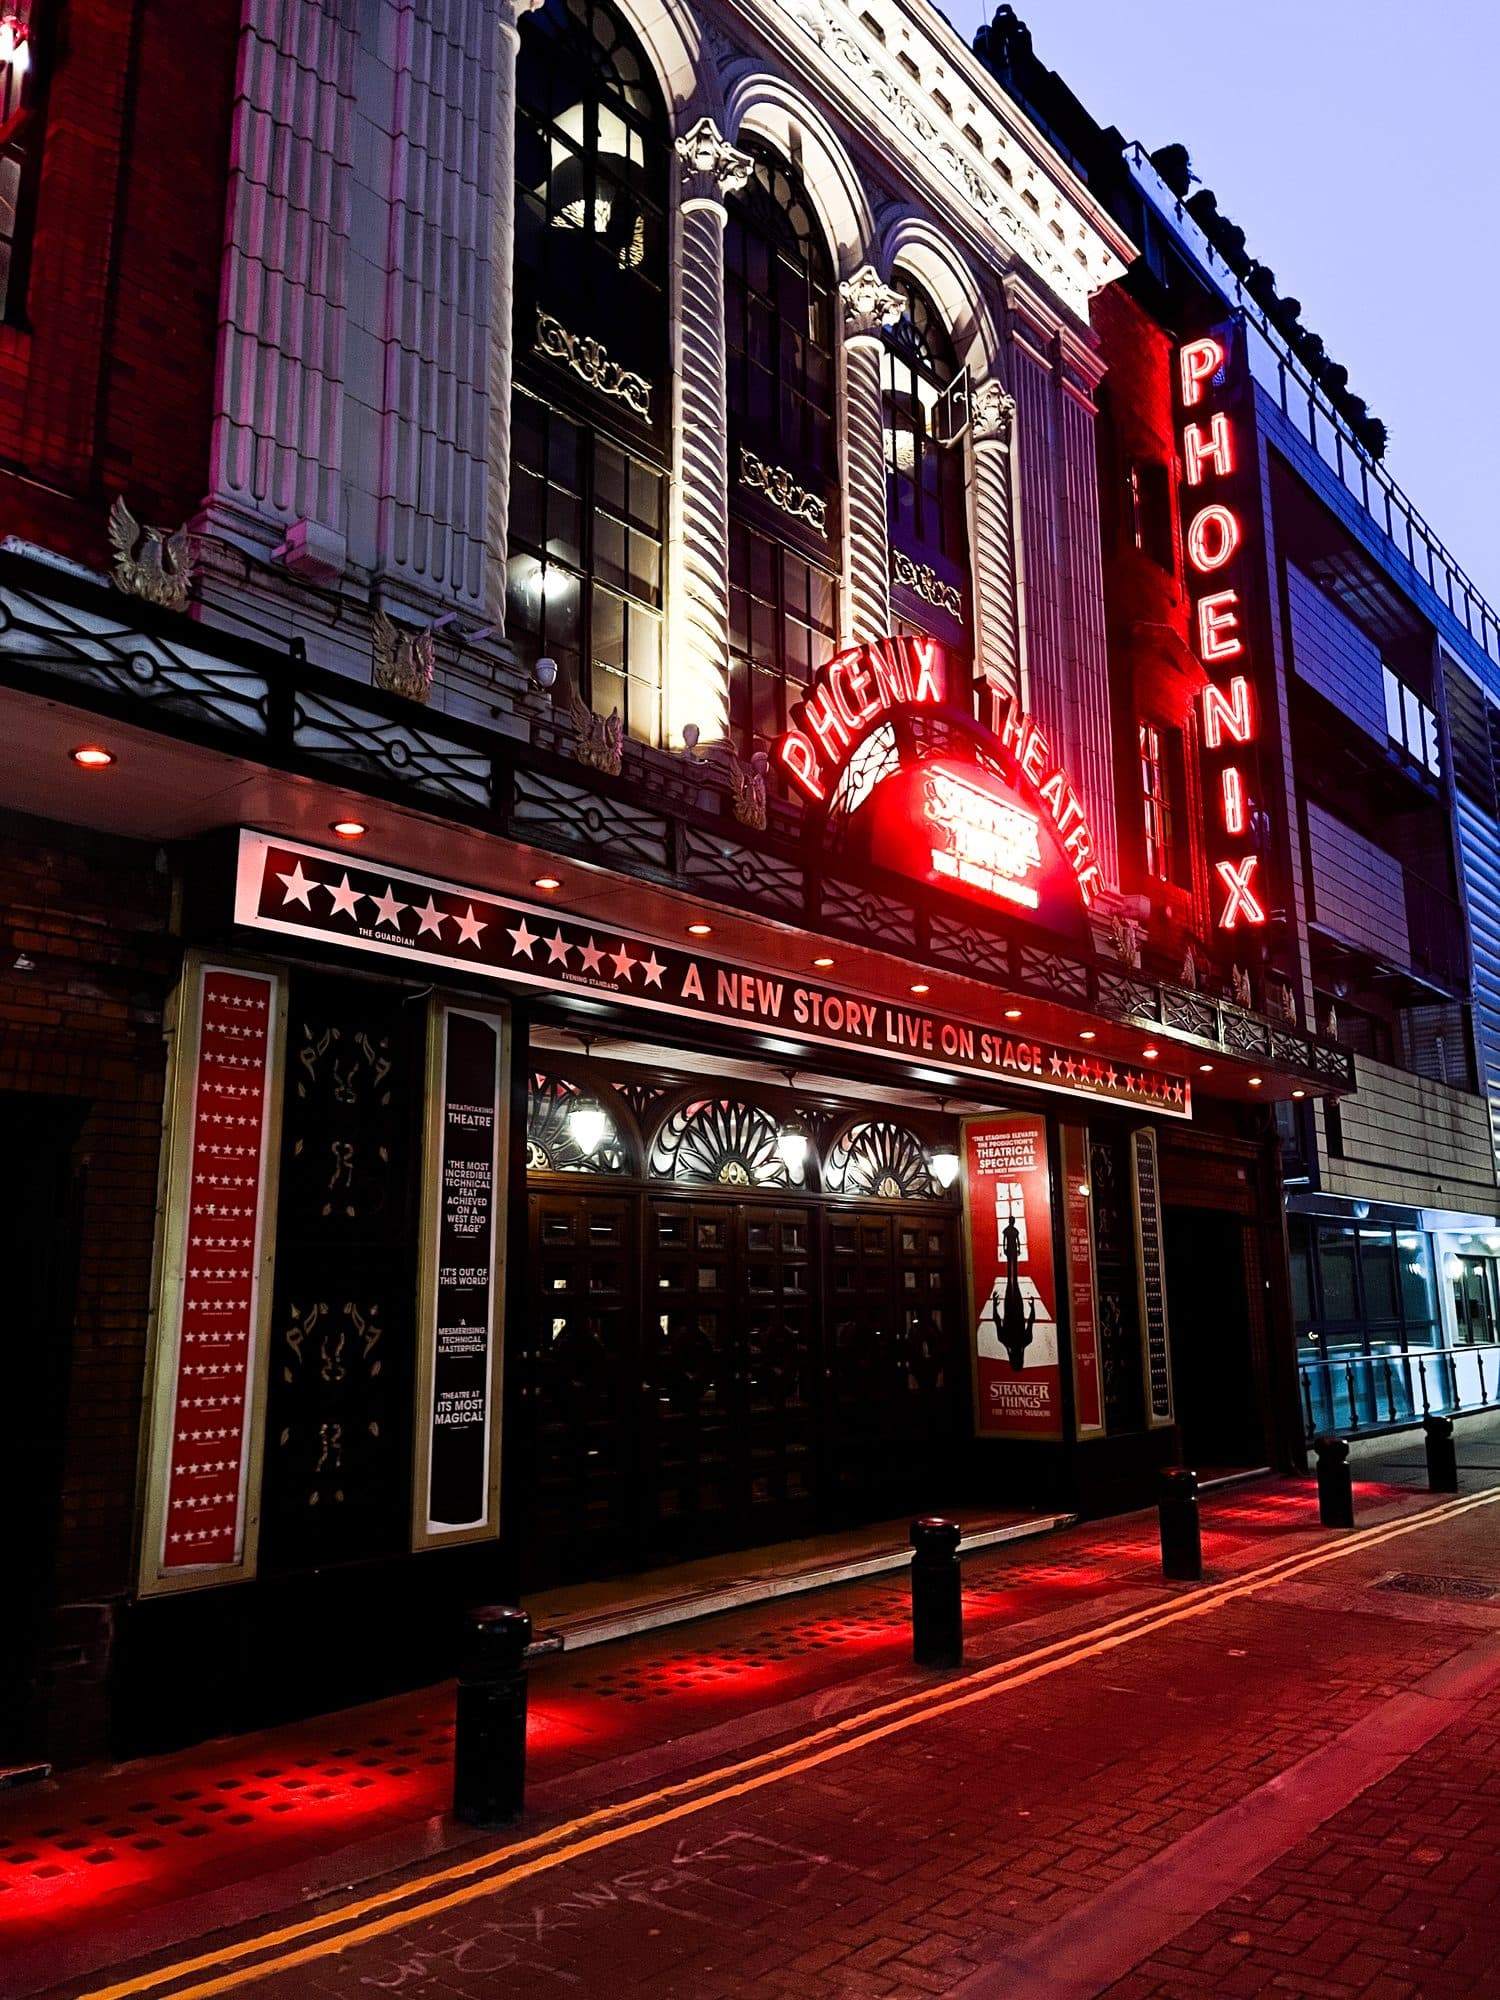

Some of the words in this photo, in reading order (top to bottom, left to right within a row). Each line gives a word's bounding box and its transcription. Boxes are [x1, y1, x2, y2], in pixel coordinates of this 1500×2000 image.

[1180, 337, 1265, 929] PHOENIX
[990, 687, 1107, 907] THEATRE
[359, 927, 373, 937] THE
[375, 931, 415, 947] GUARDIAN
[681, 962, 705, 1002] A
[717, 969, 784, 1018] NEW
[794, 988, 877, 1039] STORY
[886, 1010, 934, 1052] LIVE
[941, 1024, 974, 1061] ON
[981, 1033, 1042, 1076] STAGE
[976, 1145, 1036, 1159] THEATRICAL
[466, 1161, 489, 1171] MOST
[979, 1156, 1034, 1169] SPECTACLE
[445, 1169, 491, 1180] INCREDIBLE
[445, 1178, 491, 1189] TECHNICAL
[459, 1188, 477, 1197] FEAT
[447, 1197, 487, 1206] ACHIEVED
[457, 1206, 470, 1214] ON
[472, 1206, 478, 1215] A
[447, 1215, 468, 1223] WEST
[470, 1215, 486, 1224] END
[459, 1268, 475, 1277] OUT
[477, 1268, 488, 1277] OF
[440, 1277, 457, 1285] THIS
[442, 1336, 482, 1344] TECHNICAL
[471, 1390, 481, 1398] AT
[990, 1384, 1050, 1399] STRANGER
[437, 1401, 453, 1412] ITS
[455, 1399, 484, 1411] MOST
[1000, 1396, 1041, 1408] THINGS
